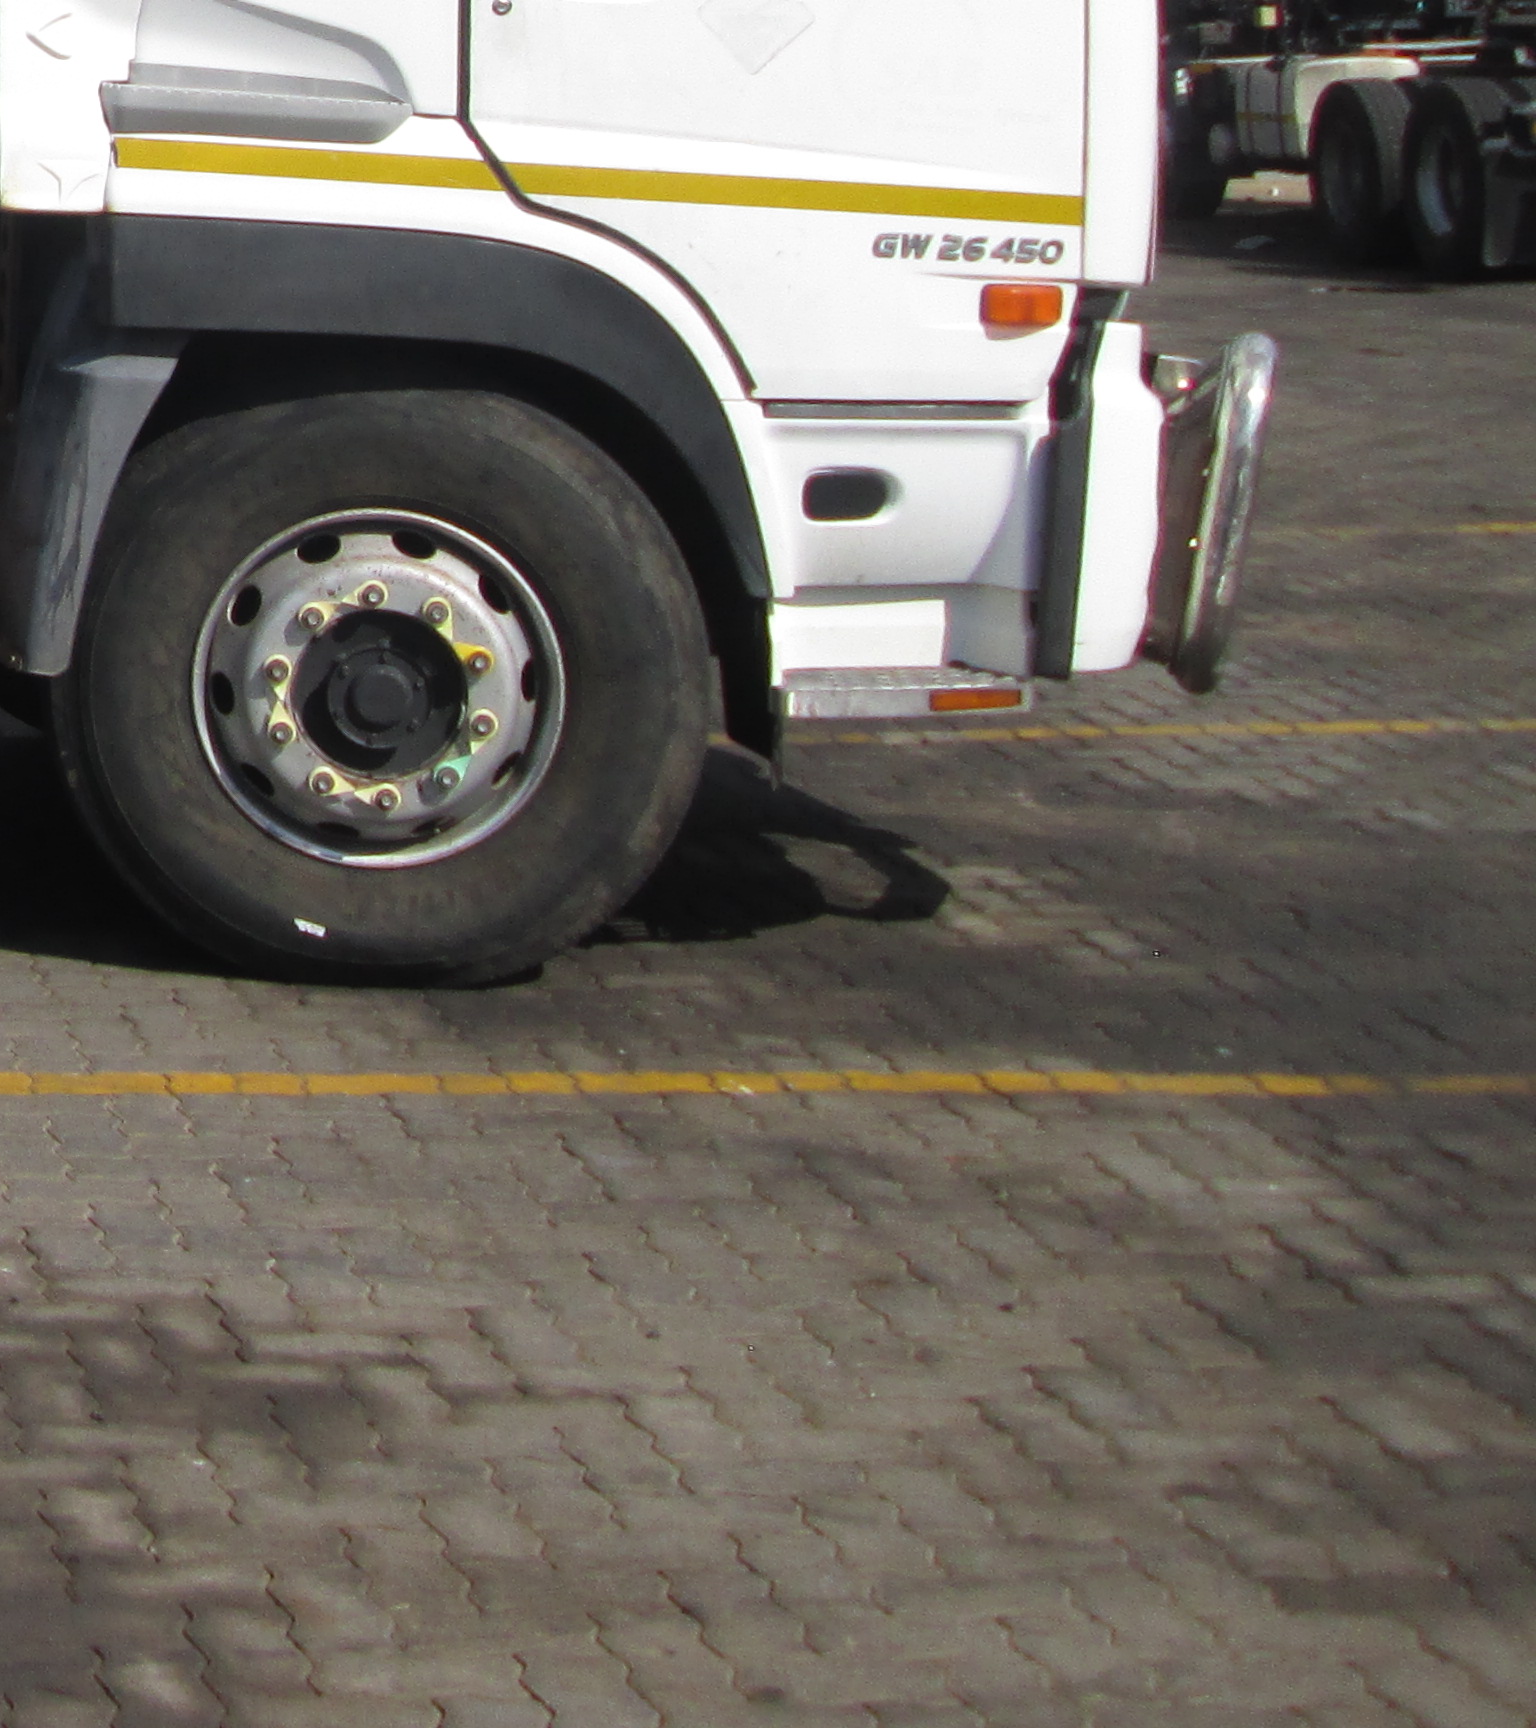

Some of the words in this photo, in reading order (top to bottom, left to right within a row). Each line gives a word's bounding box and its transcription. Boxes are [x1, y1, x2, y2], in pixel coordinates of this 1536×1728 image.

[872, 233, 933, 259] GW
[936, 234, 988, 262] 26
[990, 237, 1064, 264] 450
